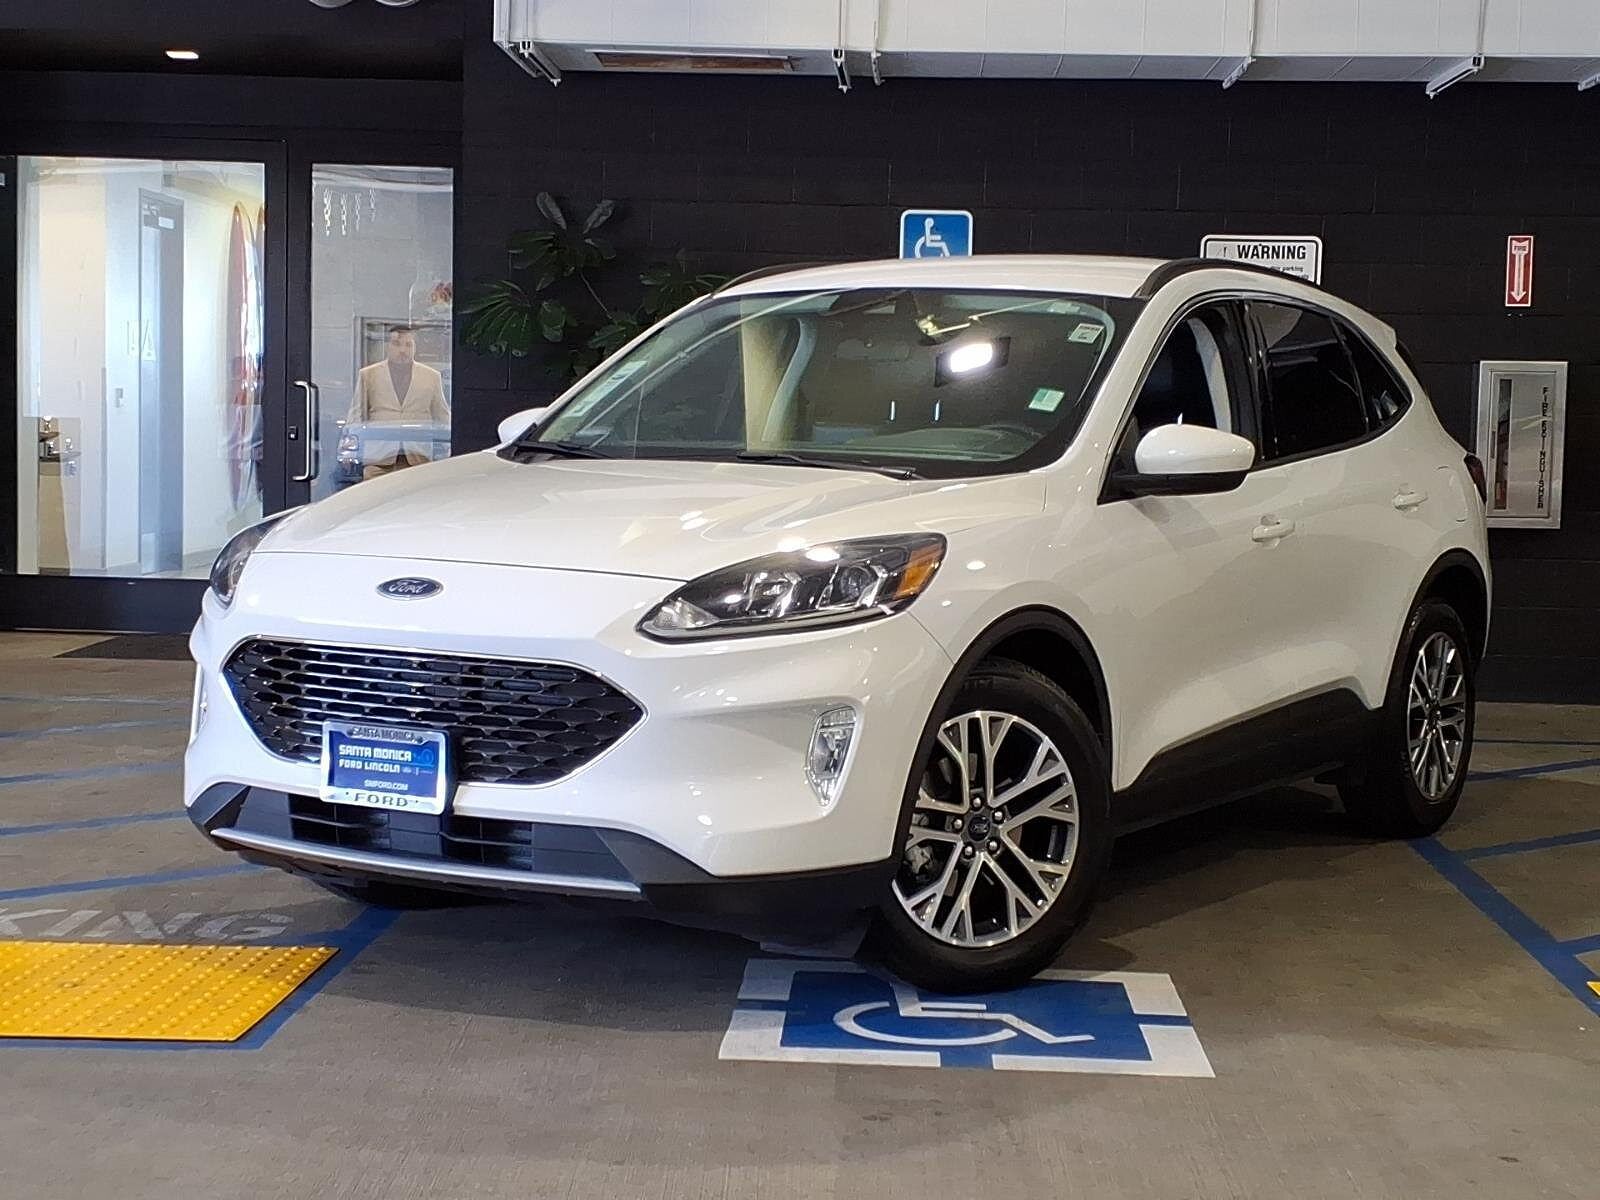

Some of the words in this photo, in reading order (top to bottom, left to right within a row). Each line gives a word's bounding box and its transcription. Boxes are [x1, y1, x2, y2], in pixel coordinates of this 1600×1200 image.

[1237, 244, 1306, 260] WARNING
[1541, 386, 1549, 417] FIRE
[339, 744, 372, 758] SANTA
[373, 747, 412, 762] MONICA
[339, 758, 363, 770] FORD
[364, 761, 401, 773] LINCOLN
[353, 792, 408, 807] FORD
